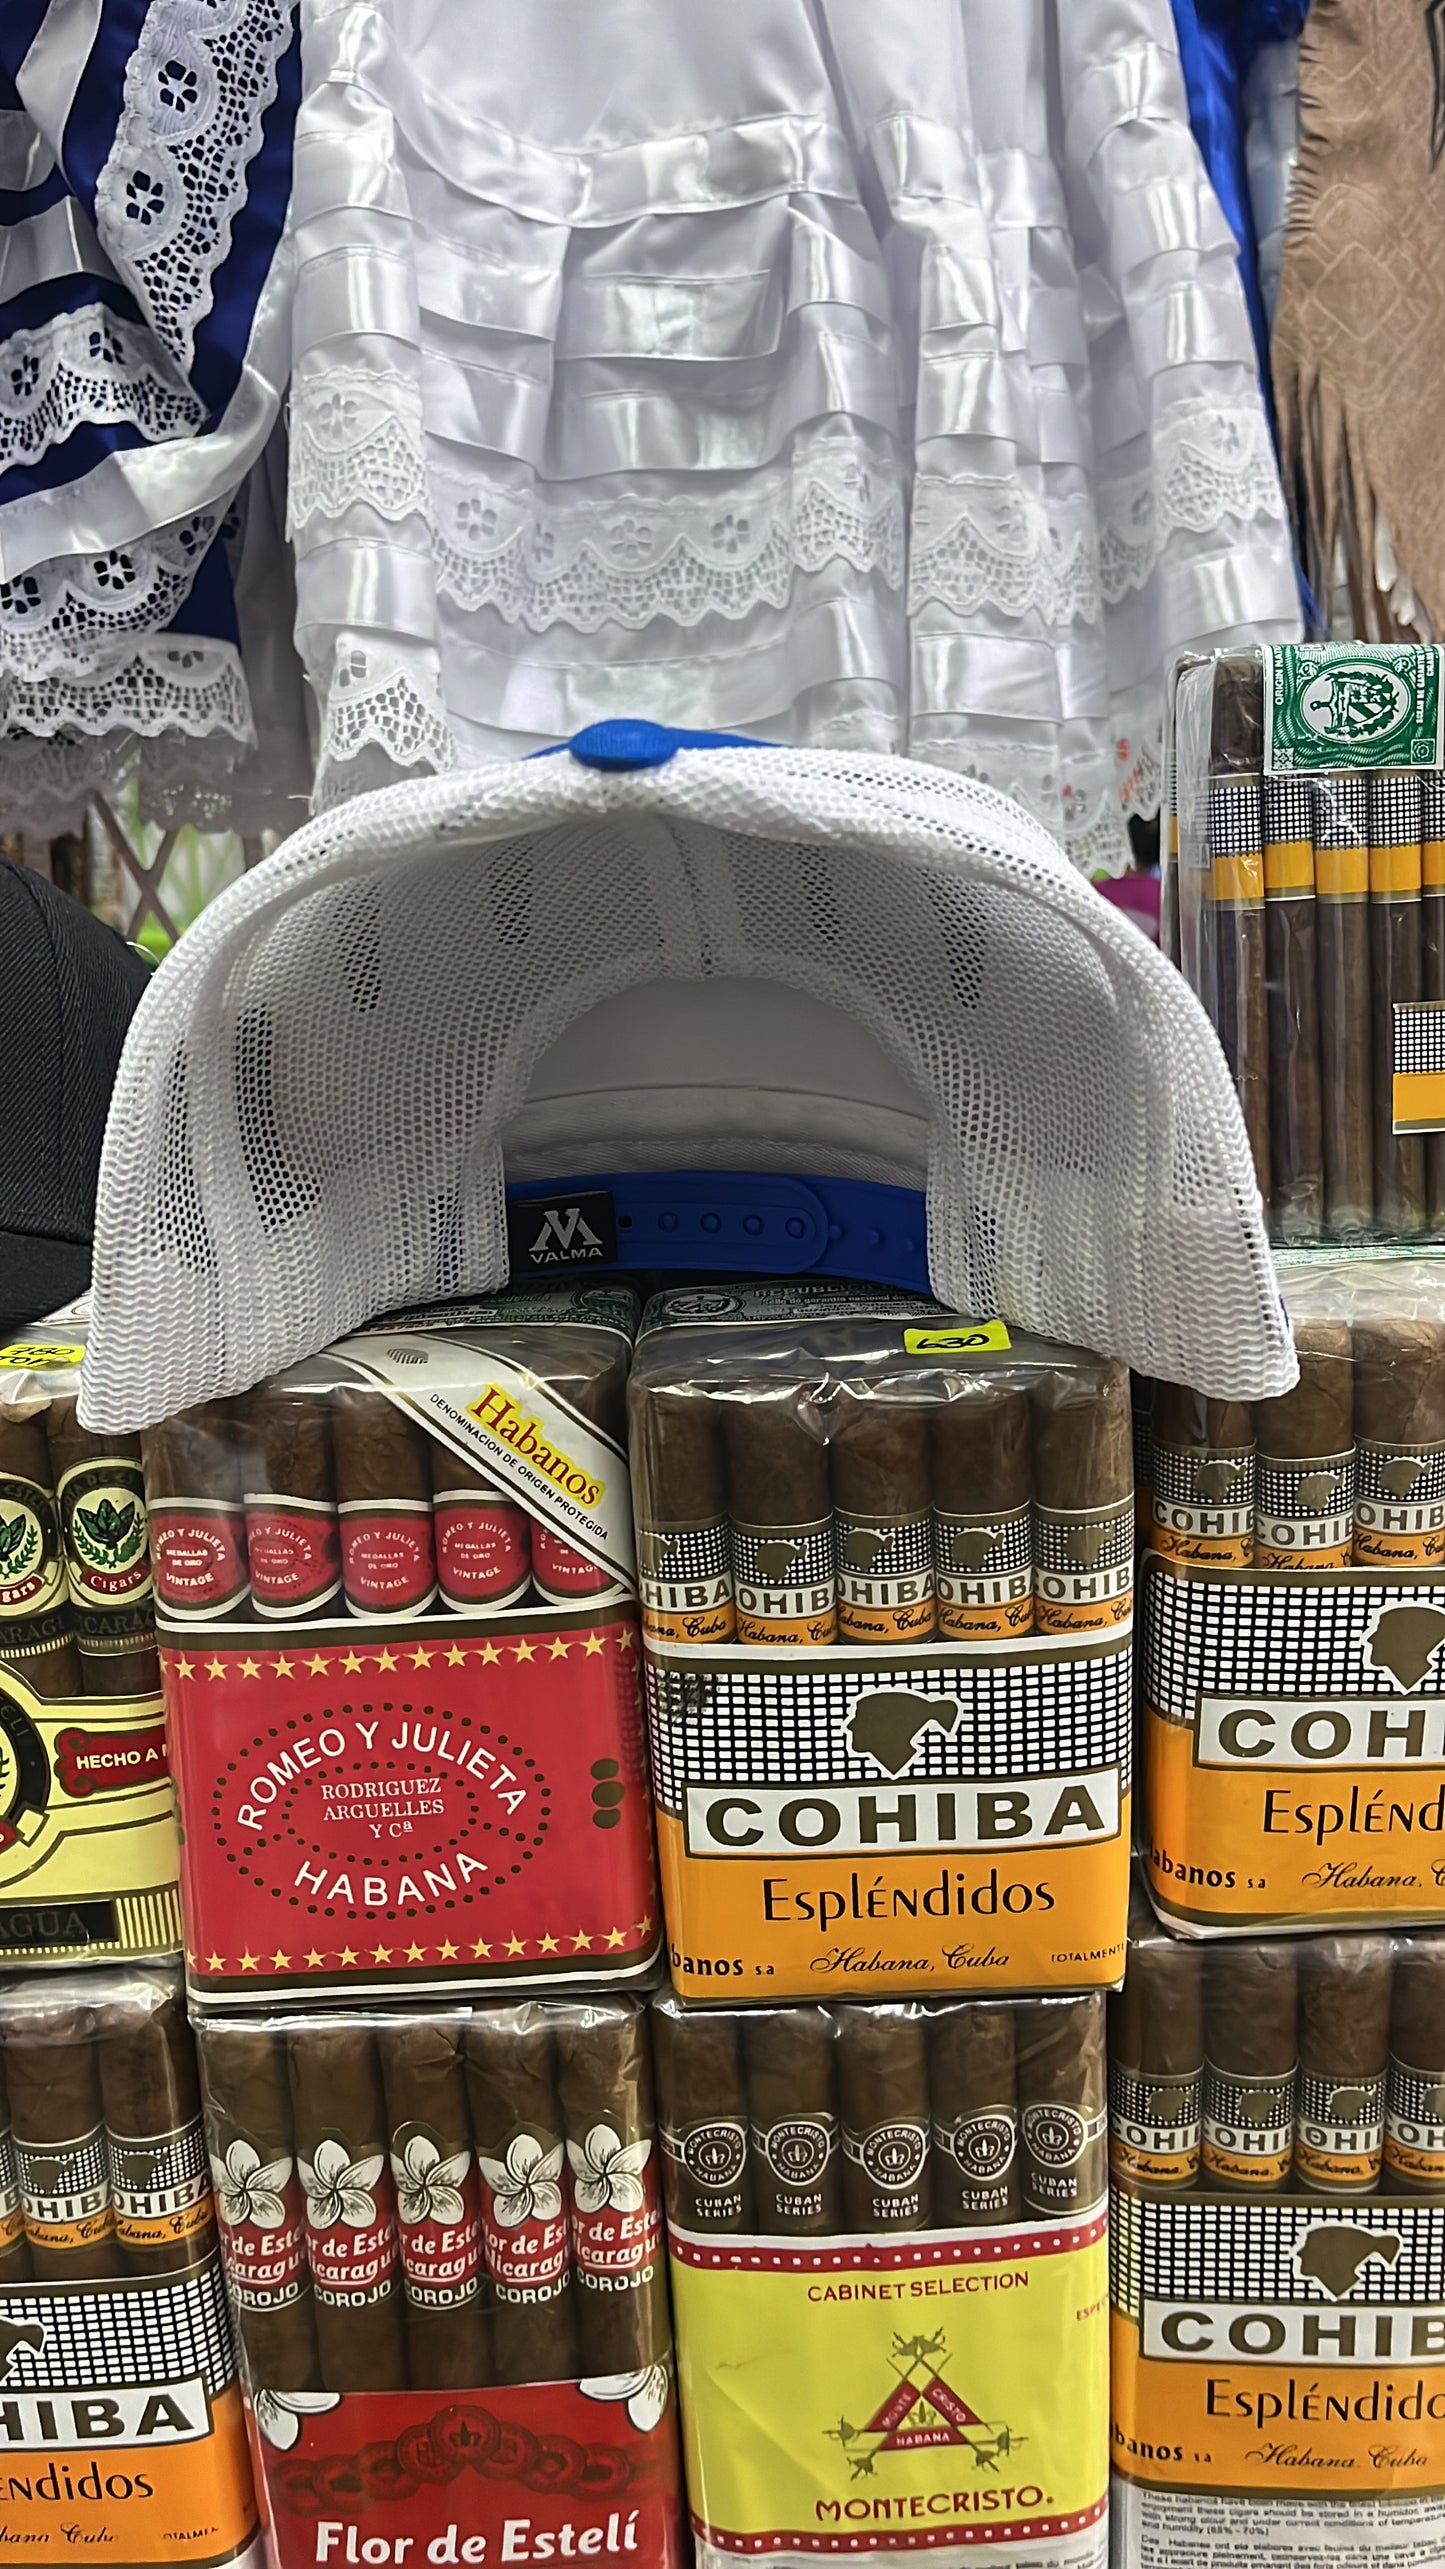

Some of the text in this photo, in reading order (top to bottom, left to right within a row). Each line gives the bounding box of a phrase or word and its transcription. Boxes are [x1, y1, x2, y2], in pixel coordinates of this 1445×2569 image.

[530, 1248, 603, 1264] VALMA
[471, 1387, 601, 1505] Habanos
[430, 1393, 503, 1456] DENOMINACION
[502, 1453, 517, 1468] DE
[517, 1466, 555, 1500] ORIGEN
[554, 1496, 608, 1540] PROTEGIDA
[1155, 1504, 1252, 1534] COHI
[177, 1528, 185, 1538] Y
[188, 1528, 226, 1561] JULIETA
[264, 1527, 312, 1560] Y JULIETA
[373, 1532, 381, 1540] Y
[385, 1532, 420, 1562] JULIETA
[467, 1521, 474, 1529] Y
[478, 1522, 512, 1552] JULIETA
[165, 1572, 214, 1586] VINTAGE
[255, 1570, 299, 1584] VINTAGE
[452, 1567, 501, 1579] VINTAGE
[552, 1563, 597, 1574] VINTAG
[90, 1571, 142, 1592] Cigars
[360, 1576, 408, 1589] VINTAGE
[640, 1578, 731, 1608] HIBA
[739, 1586, 837, 1614] OHIB
[1218, 1709, 1445, 1759] COH
[76, 1751, 141, 1770] HECHO
[145, 1747, 159, 1763] A
[237, 1721, 527, 1831] ROMEO Y JULIETA
[321, 1778, 442, 1800] RODRIGUEZ
[323, 1798, 445, 1821] ARGUELLES
[705, 1785, 1107, 1847] COHIBA
[369, 1823, 382, 1838] Y
[294, 1852, 488, 1906] HABANA
[1302, 1862, 1422, 1889] Habana,
[763, 1868, 1055, 1932] Espléndidos
[810, 1943, 1010, 1976] Habana, Cuba
[1027, 2108, 1081, 2136] MONTECRISTO
[689, 2129, 741, 2155] MONTECRISTO
[771, 2127, 826, 2149] MONTECRISTO
[866, 2129, 922, 2156] MONTECRISTO
[957, 2120, 1010, 2147] MONTECRISTO
[1032, 2143, 1075, 2161] HABANA
[696, 2164, 738, 2182] HABANA
[776, 2163, 820, 2179] HABANA
[873, 2163, 917, 2182] HABANA
[963, 2155, 1006, 2174] HABANA
[1031, 2172, 1078, 2187] CUBAN
[1032, 2183, 1078, 2197] SERIES
[695, 2193, 742, 2208] CUBAN
[776, 2193, 822, 2206] CUBAN
[872, 2193, 919, 2208] CUBAN
[962, 2186, 1008, 2200] CUBAN
[962, 2198, 1008, 2210] SERIES
[696, 2205, 742, 2218] SERIES
[776, 2204, 822, 2216] SERIES
[873, 2205, 919, 2218] SERIES
[589, 2222, 615, 2241] de
[232, 2236, 255, 2256] de
[322, 2237, 348, 2258] de
[411, 2234, 436, 2255] de
[511, 2235, 538, 2255] de
[495, 2270, 570, 2304] COROJO
[577, 2265, 654, 2292] COROJO
[807, 2271, 1029, 2303] CABINET SELECTION
[314, 2280, 392, 2307] COROJO
[1161, 2311, 1445, 2357] COHIB
[932, 2387, 967, 2422] CRISTO
[896, 2430, 951, 2447] HABANA
[1368, 2444, 1428, 2468] Cuba
[1252, 2518, 1281, 2526] under
[1263, 2509, 1297, 2517] should
[1318, 2509, 1349, 2517] stored
[315, 2509, 641, 2564] Flor de Estelí
